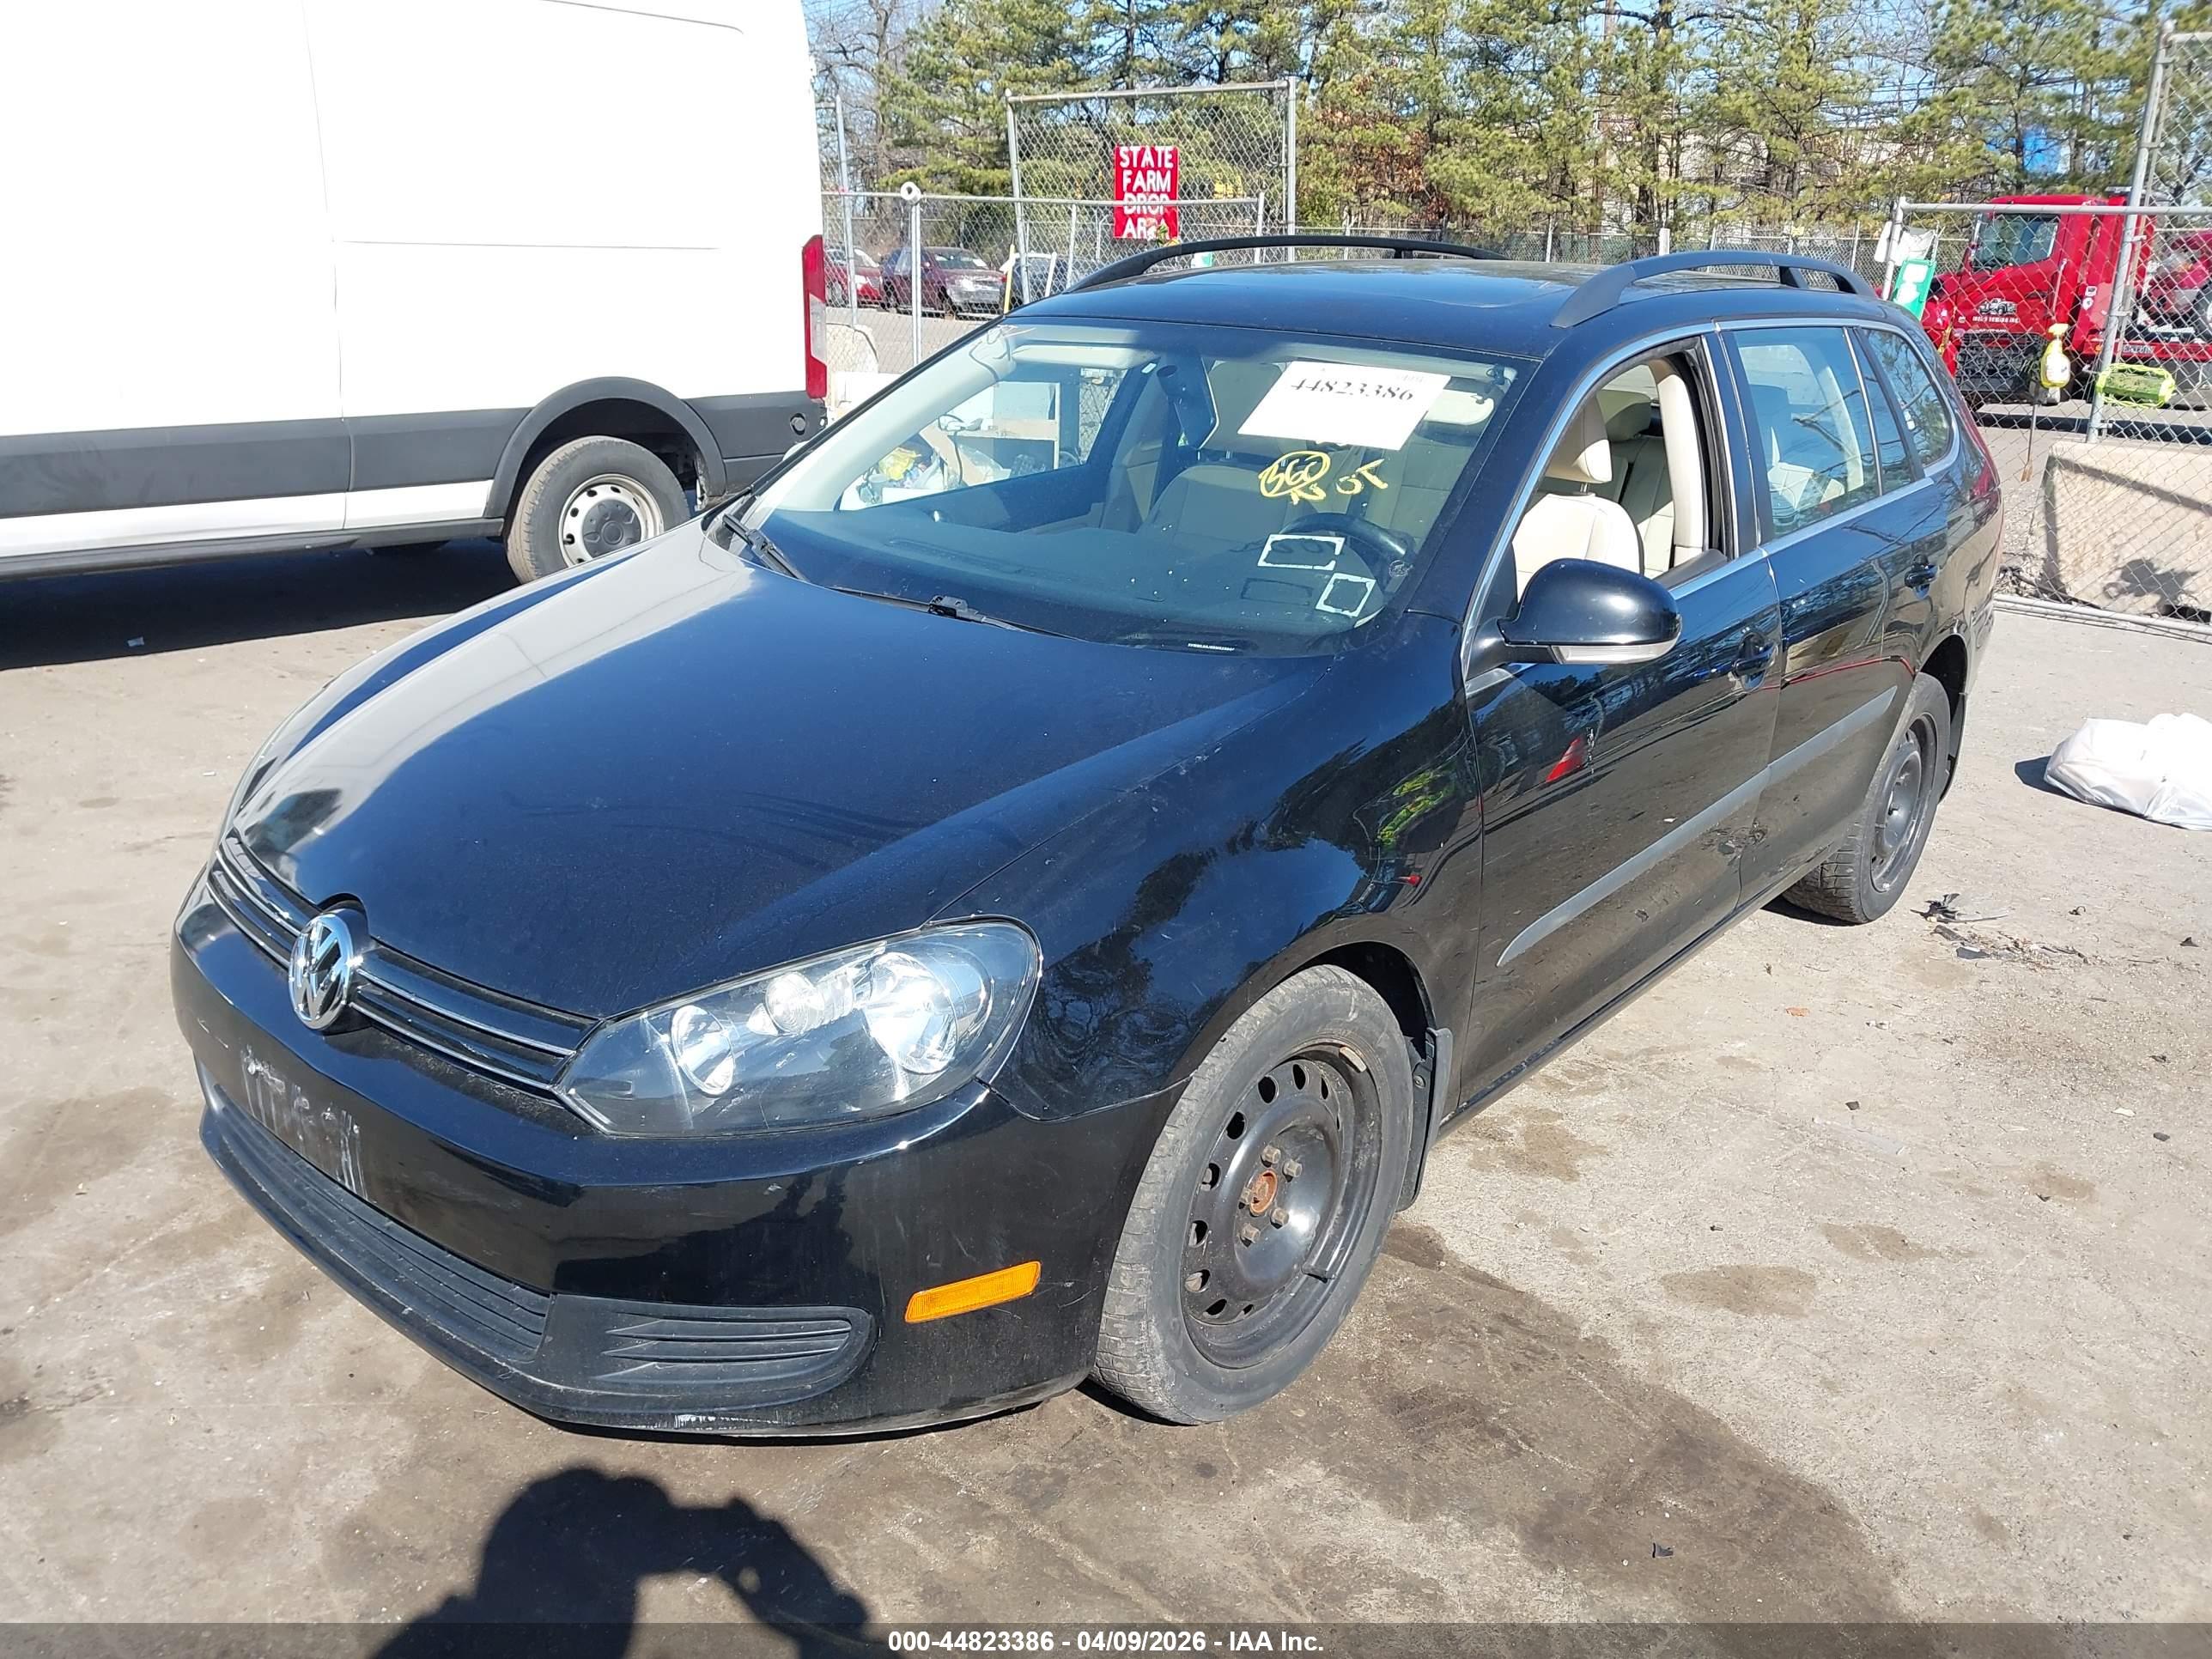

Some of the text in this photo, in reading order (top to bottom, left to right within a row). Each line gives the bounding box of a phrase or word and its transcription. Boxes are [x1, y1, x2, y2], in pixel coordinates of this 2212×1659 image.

[1119, 146, 1174, 168] STATE
[1122, 169, 1170, 192] FARM
[1123, 192, 1170, 215] DROP
[1122, 216, 1170, 240] ARA
[1291, 378, 1414, 402] 44823386
